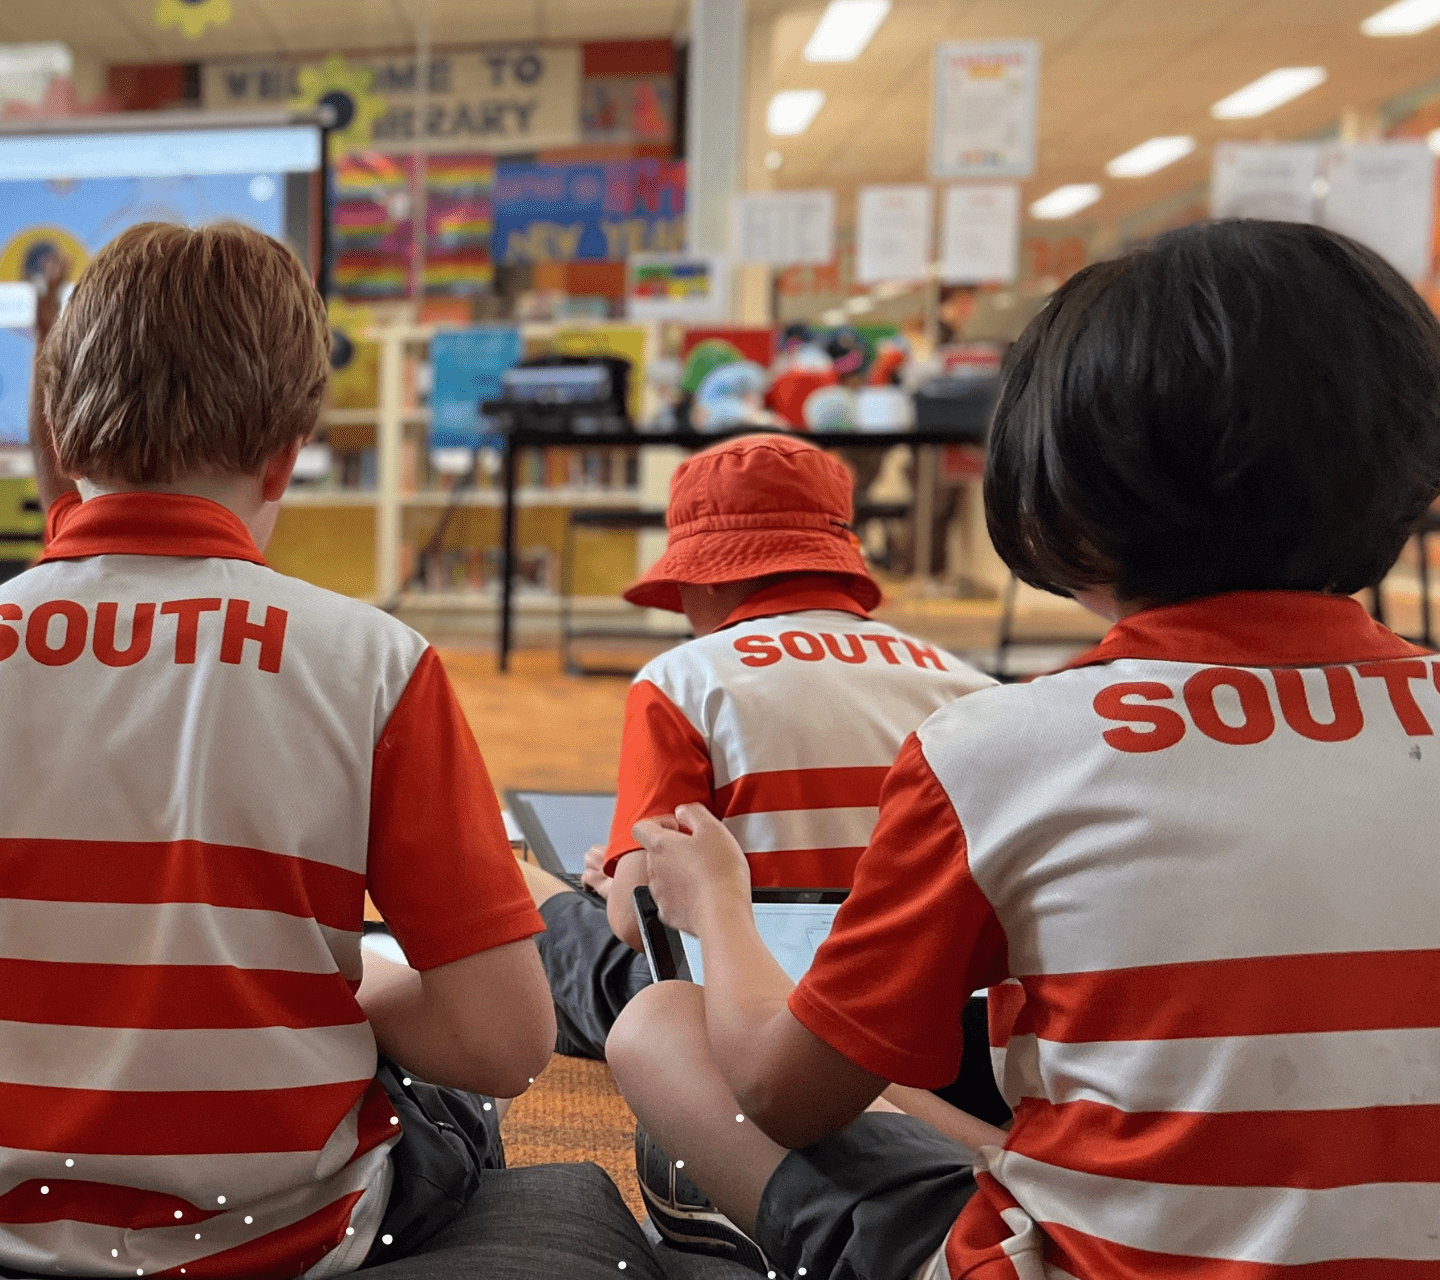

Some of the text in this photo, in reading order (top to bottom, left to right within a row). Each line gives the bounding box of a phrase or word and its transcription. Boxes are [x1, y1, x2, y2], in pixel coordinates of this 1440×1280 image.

[484, 53, 545, 86] TO
[733, 630, 949, 668] SOUTH
[1092, 660, 1440, 754] SOUT
